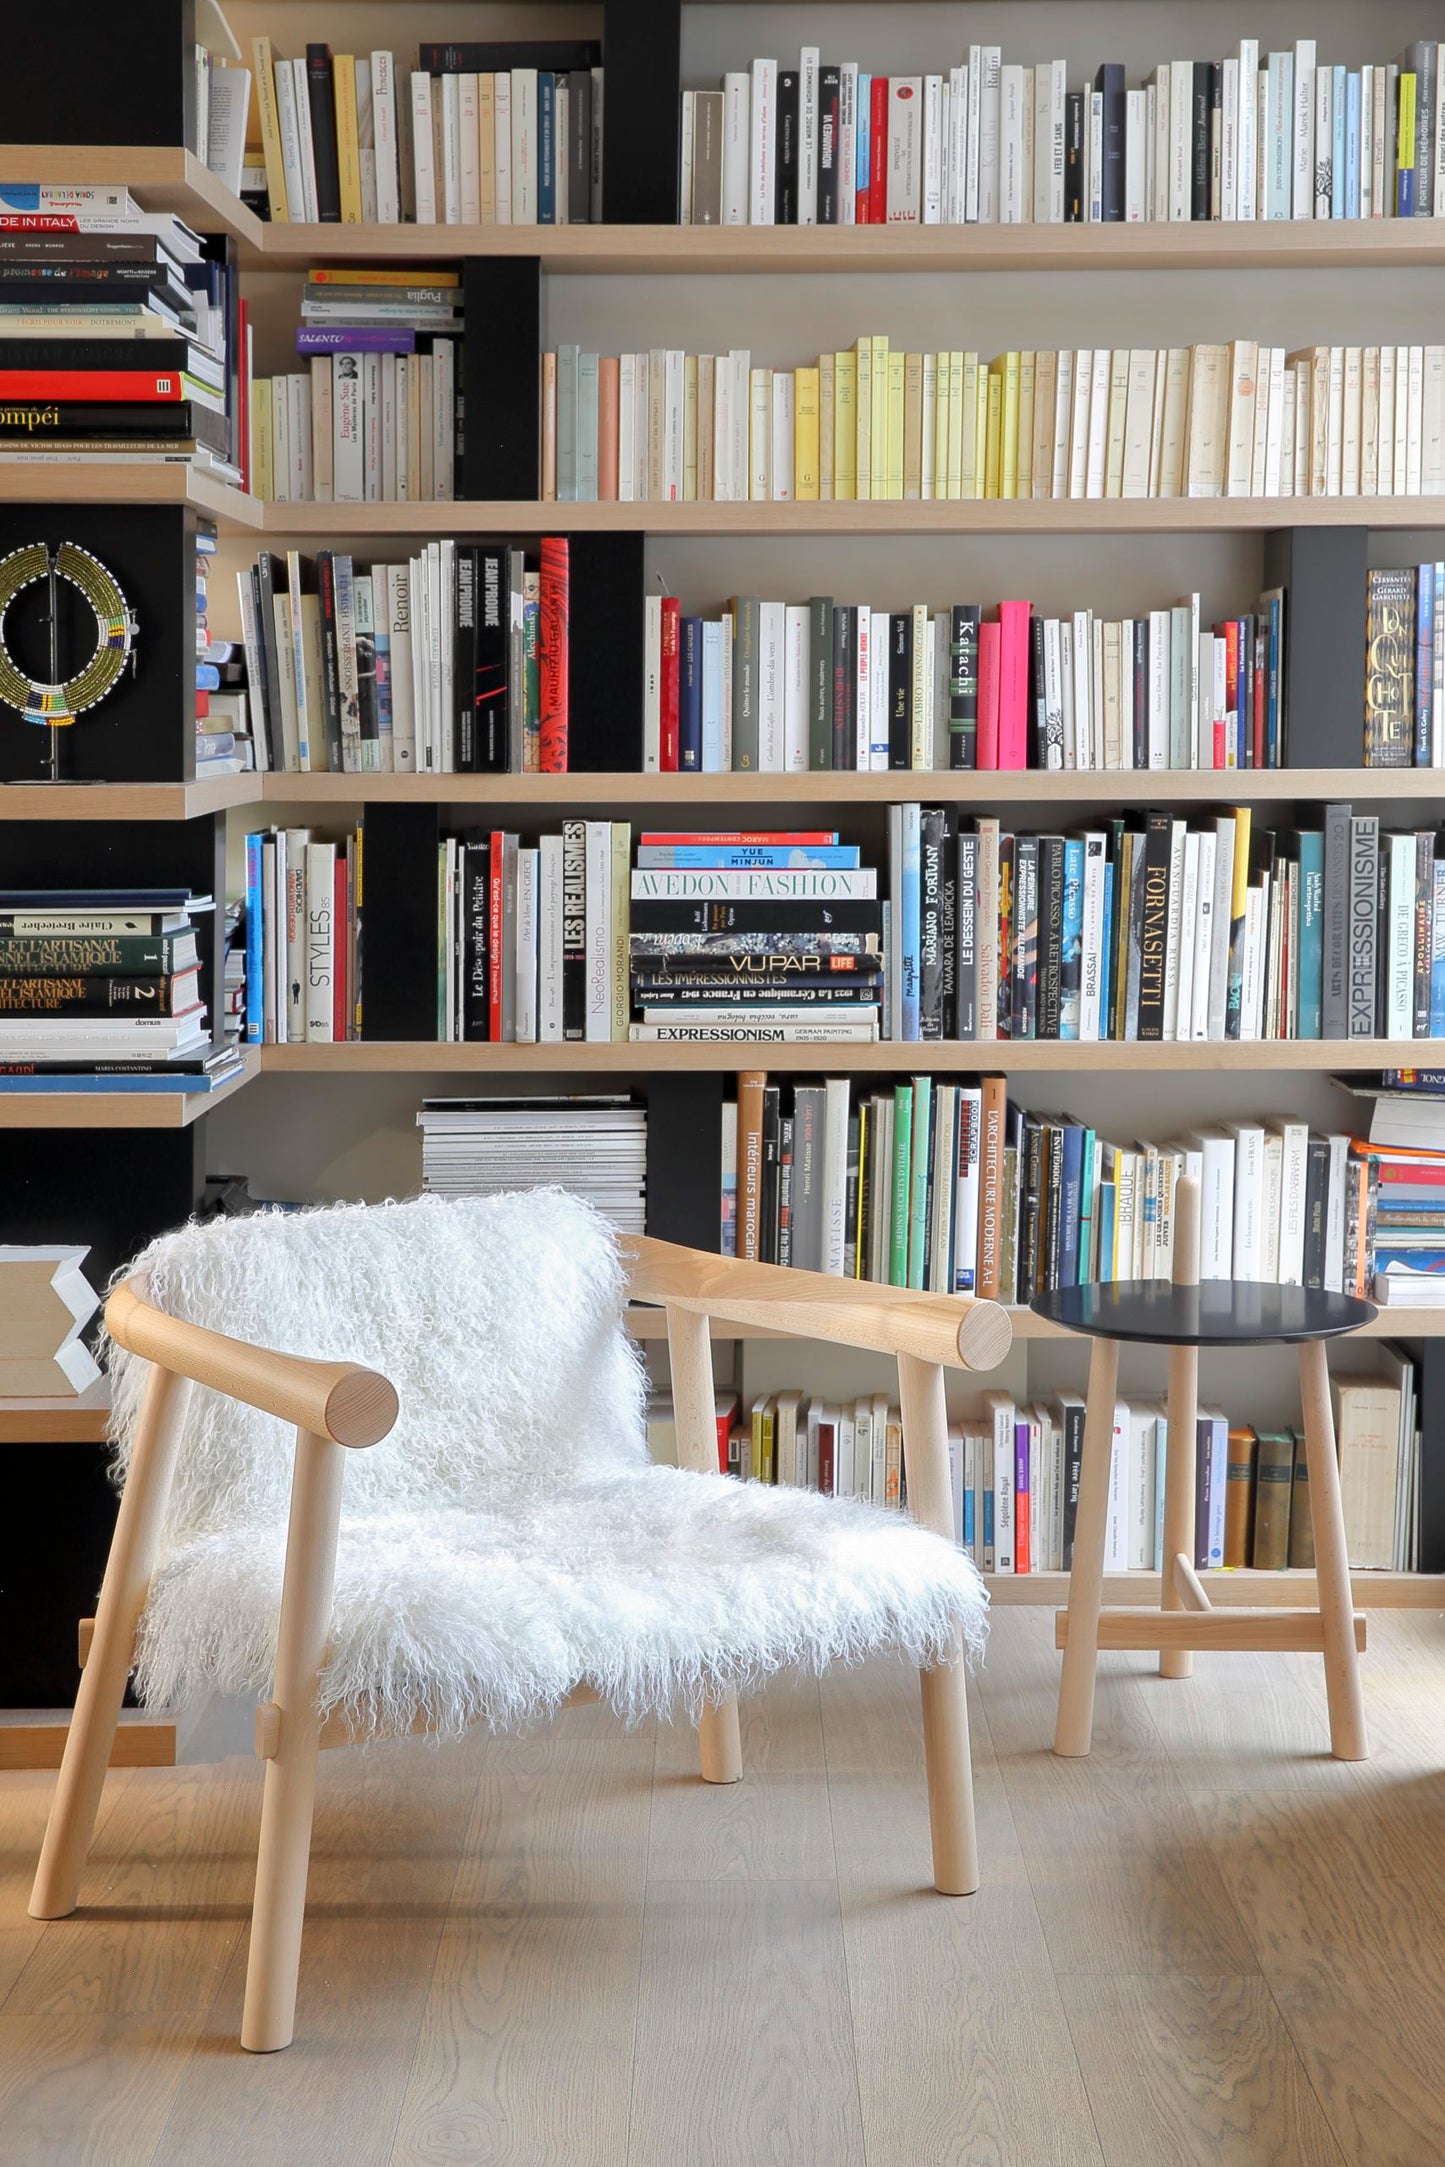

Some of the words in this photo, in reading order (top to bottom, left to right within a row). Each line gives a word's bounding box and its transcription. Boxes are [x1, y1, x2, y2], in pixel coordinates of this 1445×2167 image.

[375, 56, 388, 95] Provences
[987, 56, 999, 89] Rufin
[823, 114, 832, 122] VI
[822, 123, 832, 168] MOHAMMED
[1419, 155, 1428, 166] DE
[1418, 168, 1428, 206] PORTEUR
[22, 217, 37, 227] IN
[40, 217, 76, 227] ITALY
[407, 289, 442, 303] Puglia
[90, 318, 137, 326] DOTREMONT
[299, 333, 345, 344] SALENTO
[340, 382, 350, 401] Sue
[340, 403, 352, 439] Eugène
[459, 558, 473, 584] JEAN
[485, 557, 499, 583] JEAN
[1372, 575, 1411, 584] CERVANTES
[1377, 586, 1407, 594] GÉRARD
[393, 573, 409, 634] Renoir
[459, 585, 473, 627] PROUVÉ
[485, 584, 500, 626] PROUVÉ
[1382, 606, 1408, 637] DON
[525, 609, 537, 660] Alechinsky
[767, 641, 776, 658] vent
[957, 620, 974, 695] Katachi
[743, 664, 751, 687] monde
[766, 659, 776, 670] du
[818, 660, 826, 687] modernes
[766, 671, 776, 701] L'ombre
[896, 688, 905, 700] vie
[743, 695, 752, 718] Quitter
[818, 707, 826, 721] Nous
[896, 702, 905, 718] Une
[1420, 708, 1430, 727] Gehry
[1420, 734, 1429, 752] Frank
[564, 823, 585, 915] REALISMES
[962, 841, 974, 877] GESTE
[1027, 860, 1036, 870] LA
[1051, 844, 1061, 878] PABLO
[1069, 849, 1080, 872] Late
[295, 868, 303, 892] DAVID
[637, 874, 729, 895] AVEDON
[749, 874, 853, 895] FASHION
[925, 844, 938, 904] FORTUNY
[962, 880, 974, 896] DU
[1018, 859, 1028, 930] EXPRESSIONNISTE
[1026, 871, 1036, 911] PEINTURE
[1068, 878, 1079, 920] Picasso
[1170, 846, 1181, 939] AVANGUARDIA
[295, 892, 303, 914] HICKS
[943, 880, 955, 932] LEMPICKA
[1051, 881, 1062, 930] PICASSO:
[1397, 905, 1409, 919] DE
[564, 919, 585, 949] LES
[962, 899, 974, 948] DESSEIN
[1351, 821, 1376, 1036] EXPRESSIONISME
[8, 939, 28, 952] ET
[30, 939, 119, 952] L'ARTISANAT
[309, 910, 330, 987] STYLES
[321, 896, 330, 908] 85
[924, 911, 938, 966] MARIANO
[944, 934, 954, 949] DE
[1051, 932, 1060, 941] A
[1141, 865, 1167, 1008] FORNASETTI
[1397, 921, 1409, 957] GRECO
[40, 951, 122, 964] ISLAMIQUE
[616, 935, 624, 982] MORANDI
[729, 955, 766, 972] VU
[770, 955, 821, 972] PAR
[832, 958, 853, 969] LIFE
[962, 950, 974, 966] LE
[1017, 931, 1027, 980] ALLEMANDE
[1397, 959, 1410, 967] À
[590, 926, 606, 1014] NeoRealismo
[652, 973, 673, 985] LES
[674, 972, 787, 985] IMPRESSIONNISTES
[944, 951, 954, 996] TAMARA
[980, 944, 993, 997] Salvador
[1167, 948, 1177, 989] RUSSA
[12, 978, 85, 989] L'ARTISANAT
[20, 988, 86, 1000] ISLAMIQUE
[134, 986, 156, 999] 2
[702, 988, 742, 999] France
[742, 989, 757, 998] en
[763, 988, 816, 1000] Céramique
[818, 989, 832, 998] La
[1047, 943, 1061, 1034] RETROSPECTIVE
[1396, 970, 1408, 1012] PICASSO
[616, 986, 624, 1027] GIORGIO
[717, 1013, 747, 1024] bologna
[749, 1012, 776, 1022] vecchia
[135, 1018, 161, 1026] domus
[657, 1027, 786, 1042] EXPRESSIONISM
[969, 1100, 979, 1164] SCRAPBOOK
[1030, 1130, 1039, 1154] ANNE
[803, 1142, 812, 1172] Matisse
[985, 1109, 999, 1204] L'ARCHITECTURE
[1052, 1134, 1062, 1189] MODIGLIANI
[1029, 1154, 1038, 1188] GEDDES
[1287, 1150, 1298, 1200] D'ABRAHAM
[803, 1173, 811, 1195] Henri
[895, 1178, 906, 1212] SECRETS
[1119, 1170, 1133, 1223] BRAQUE
[1156, 1200, 1164, 1233] GRANDES
[1288, 1200, 1297, 1220] FILS
[830, 1198, 842, 1270] MATISSE
[895, 1213, 906, 1250] JARDINS
[984, 1206, 997, 1265] MODERNE
[1288, 1220, 1297, 1236] LES
[1156, 1234, 1164, 1248] LES
[983, 1267, 996, 1287] A-L
[1072, 1461, 1080, 1481] Frère
[1000, 1476, 1009, 1496] Royal
[1070, 1483, 1079, 1503] Tariq
[1000, 1497, 1010, 1528] Ségolène
